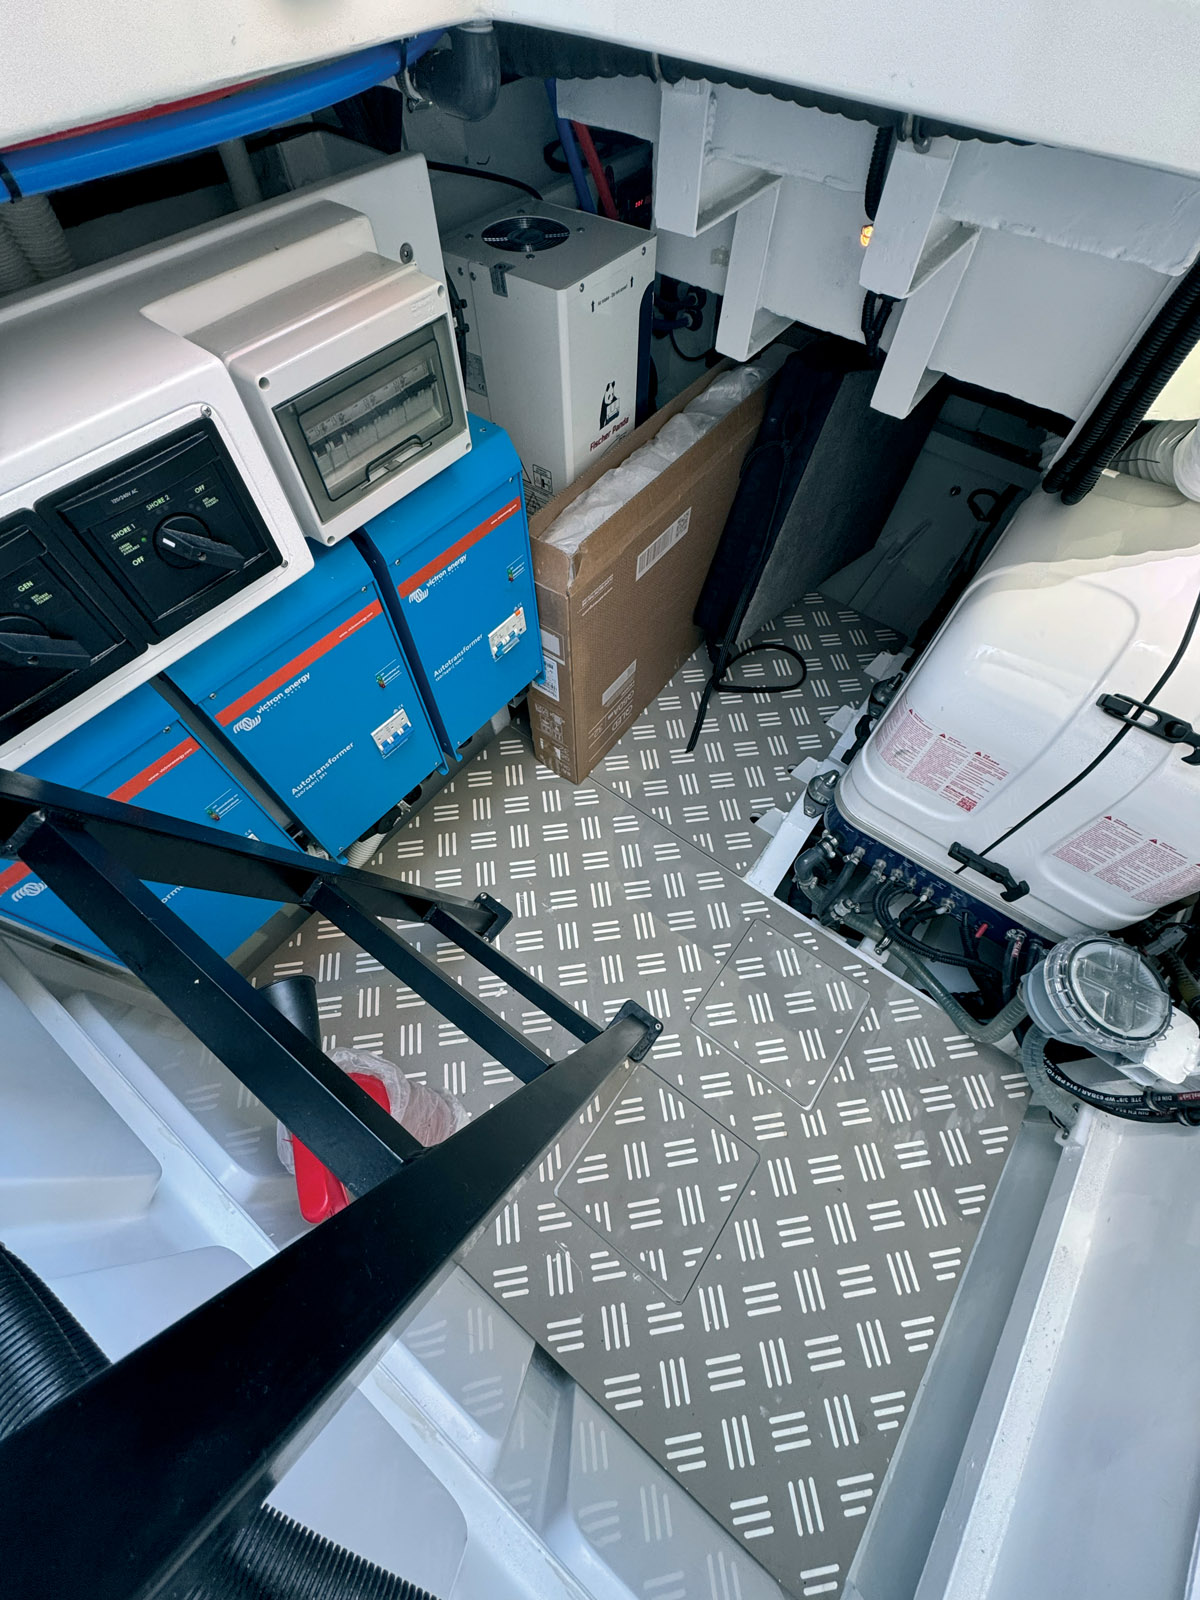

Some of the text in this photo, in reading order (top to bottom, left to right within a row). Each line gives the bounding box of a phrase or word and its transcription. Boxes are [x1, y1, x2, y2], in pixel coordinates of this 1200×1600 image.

[589, 431, 611, 452] Fischer
[612, 416, 630, 435] Panda
[194, 484, 205, 494] OFF
[146, 496, 165, 511] SHORE
[110, 526, 131, 540] SHORE
[132, 556, 144, 566] OFF
[426, 570, 446, 588] victron
[447, 554, 467, 571] energy
[18, 580, 34, 592] GEN
[434, 634, 483, 678] Autotransformer
[256, 692, 284, 714] victron
[284, 672, 311, 694] energy
[612, 704, 632, 731] QLED
[291, 741, 354, 796] Autotransformer
